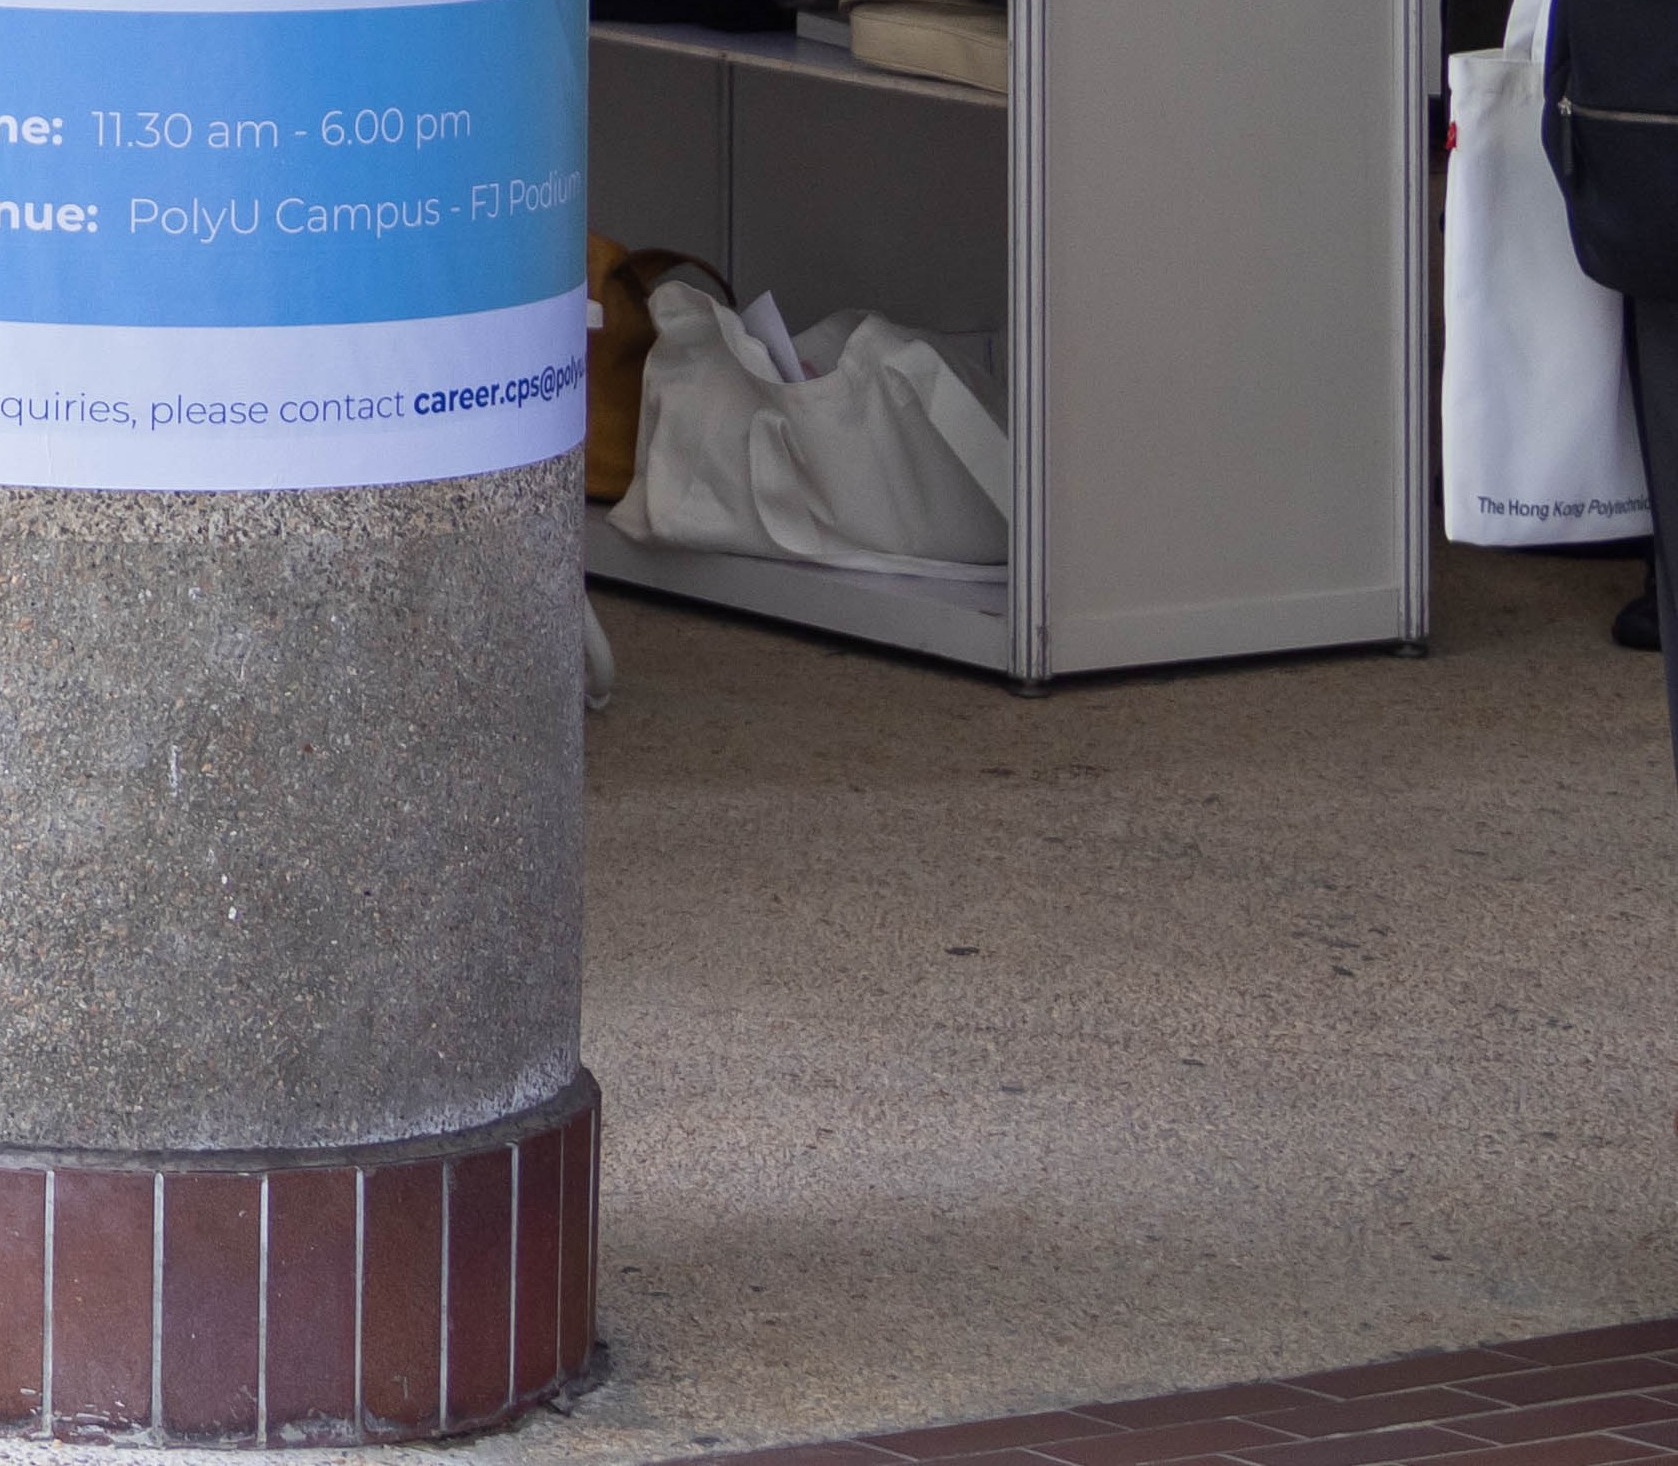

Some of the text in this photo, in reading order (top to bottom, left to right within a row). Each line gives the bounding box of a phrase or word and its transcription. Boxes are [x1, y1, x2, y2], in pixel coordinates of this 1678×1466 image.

[91, 110, 192, 149] 11.30
[207, 115, 280, 150] am
[321, 107, 403, 146] 6.00
[416, 105, 471, 147] pm
[128, 198, 258, 242] PolyU
[276, 193, 439, 238] Campus
[472, 182, 499, 220] FJ
[151, 394, 268, 431] please
[280, 388, 405, 426] contact
[1478, 496, 1504, 514] The
[1509, 501, 1549, 520] Hong
